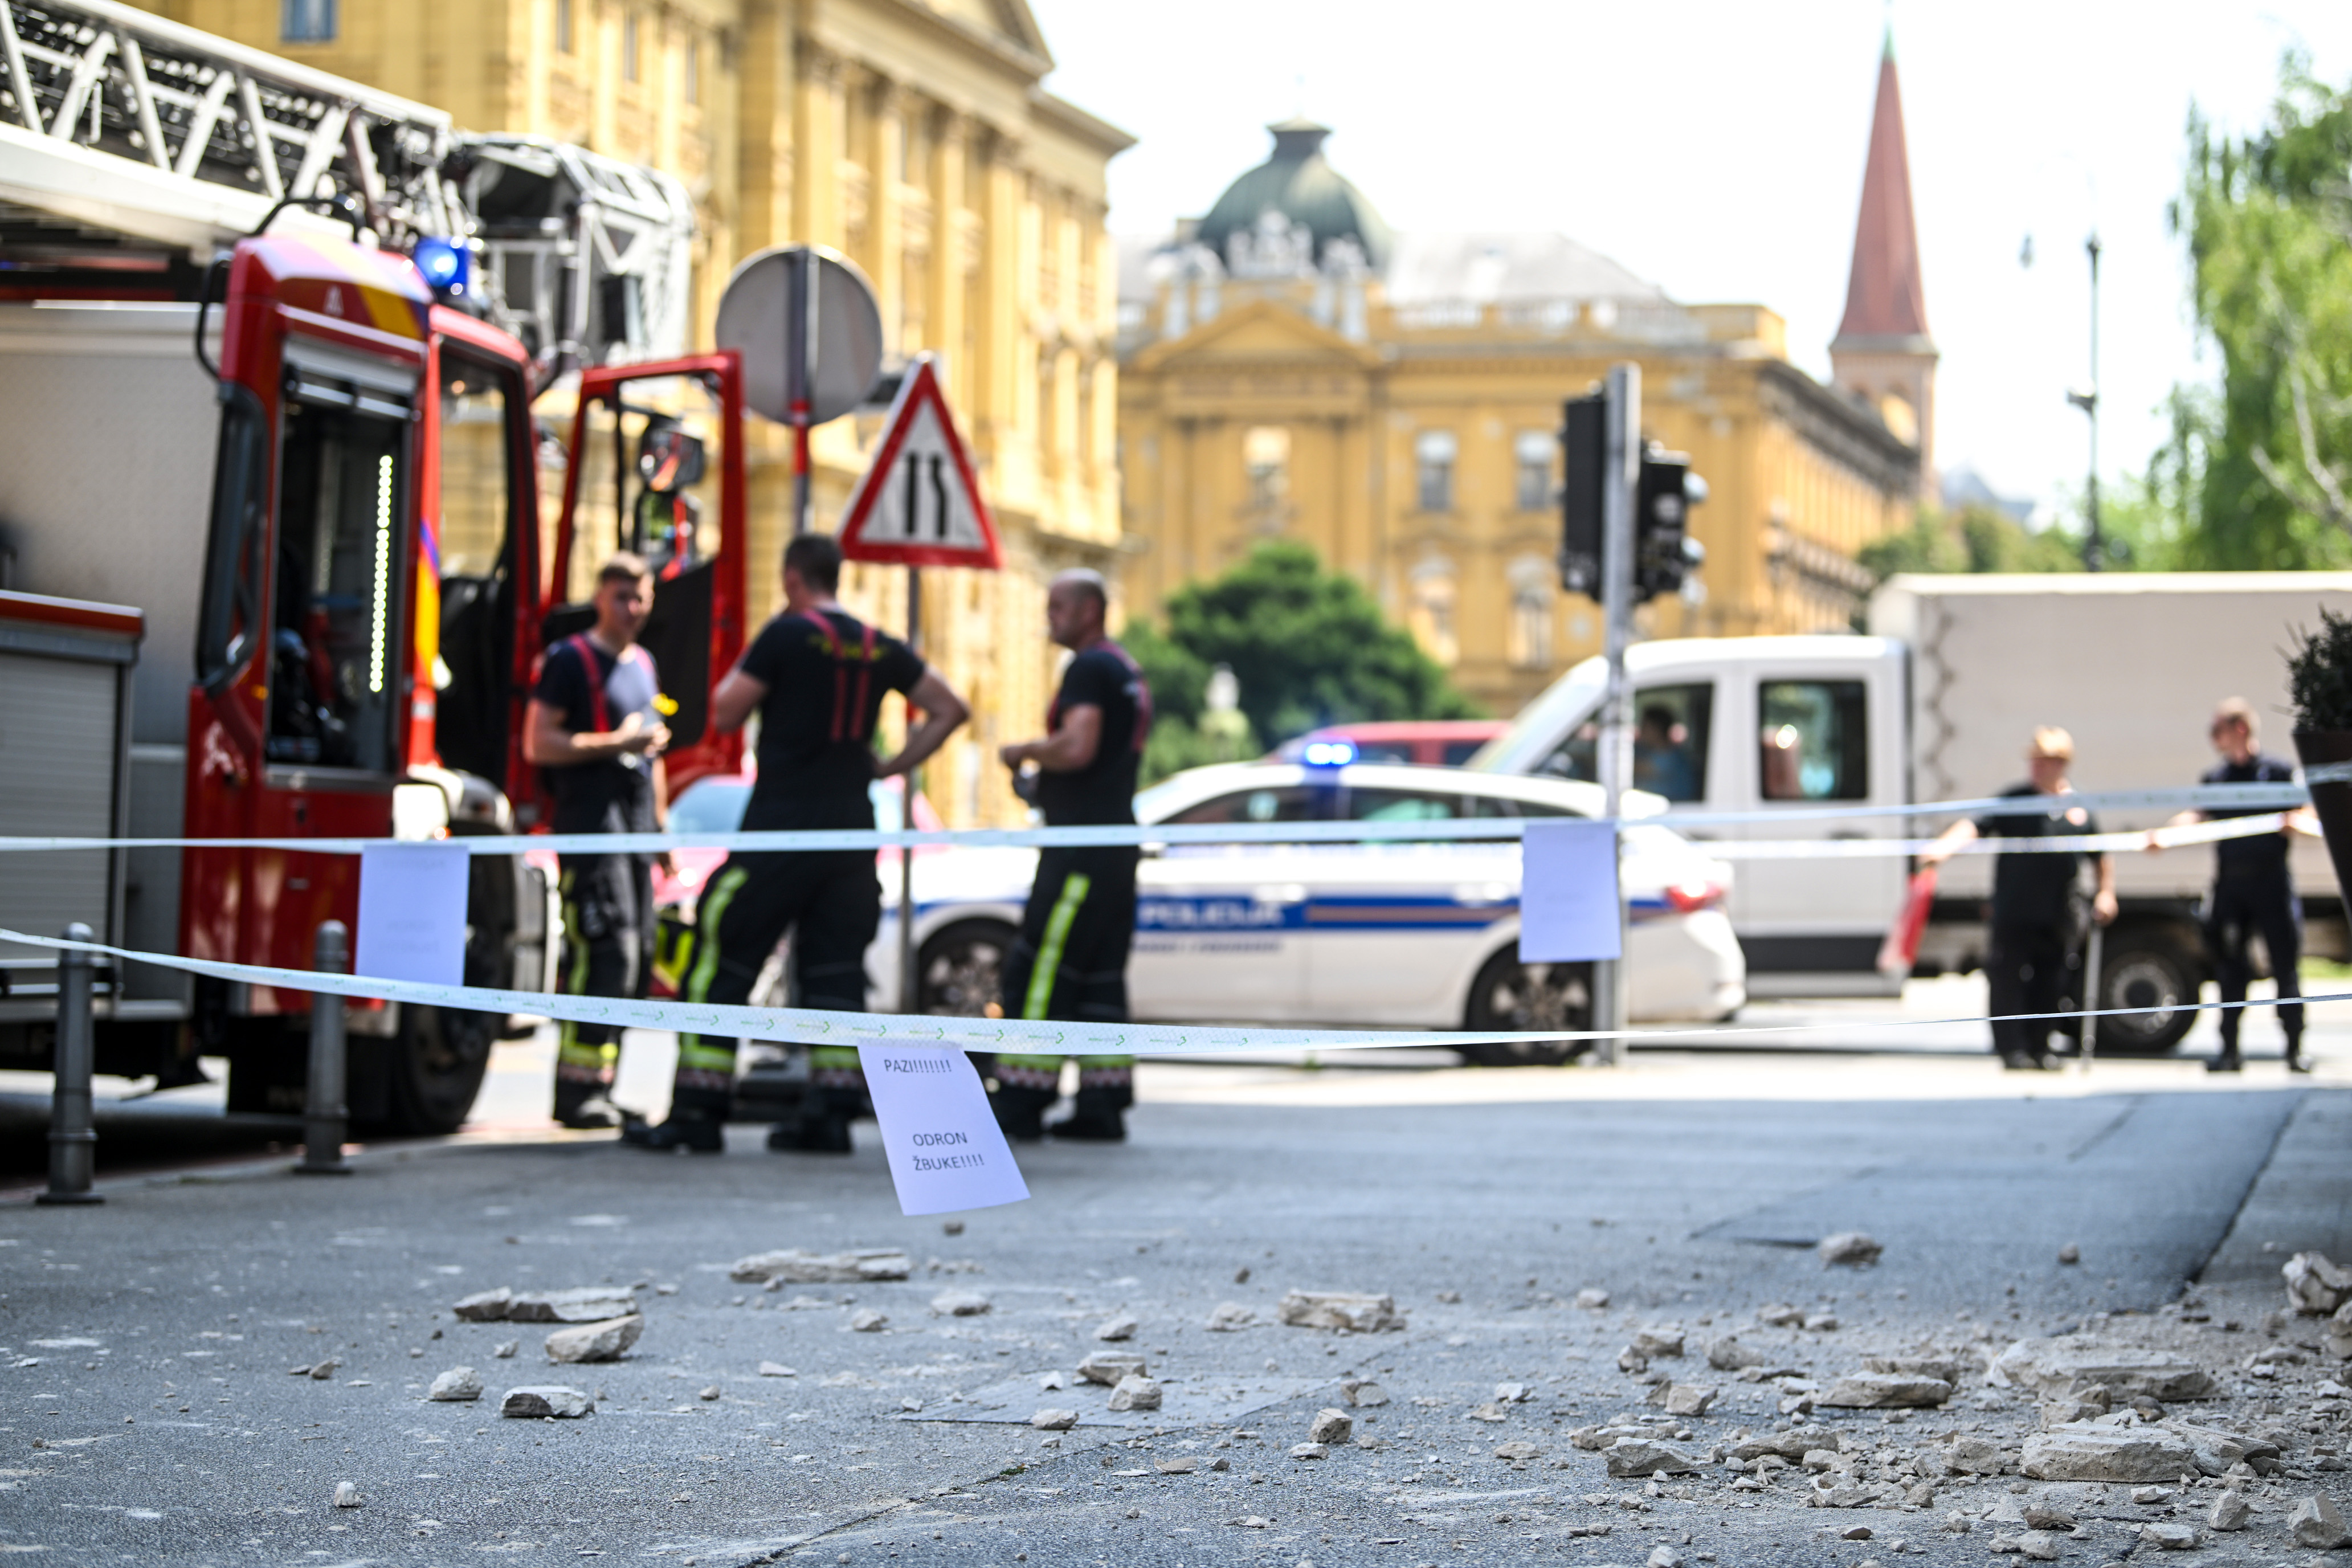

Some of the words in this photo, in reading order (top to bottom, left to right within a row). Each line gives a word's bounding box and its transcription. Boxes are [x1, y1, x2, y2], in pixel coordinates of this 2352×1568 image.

[884, 1059, 952, 1073] PAZI!!!!!!!
[913, 1132, 967, 1146] ODRON
[912, 1153, 985, 1171] ŽBUKE!!!!
